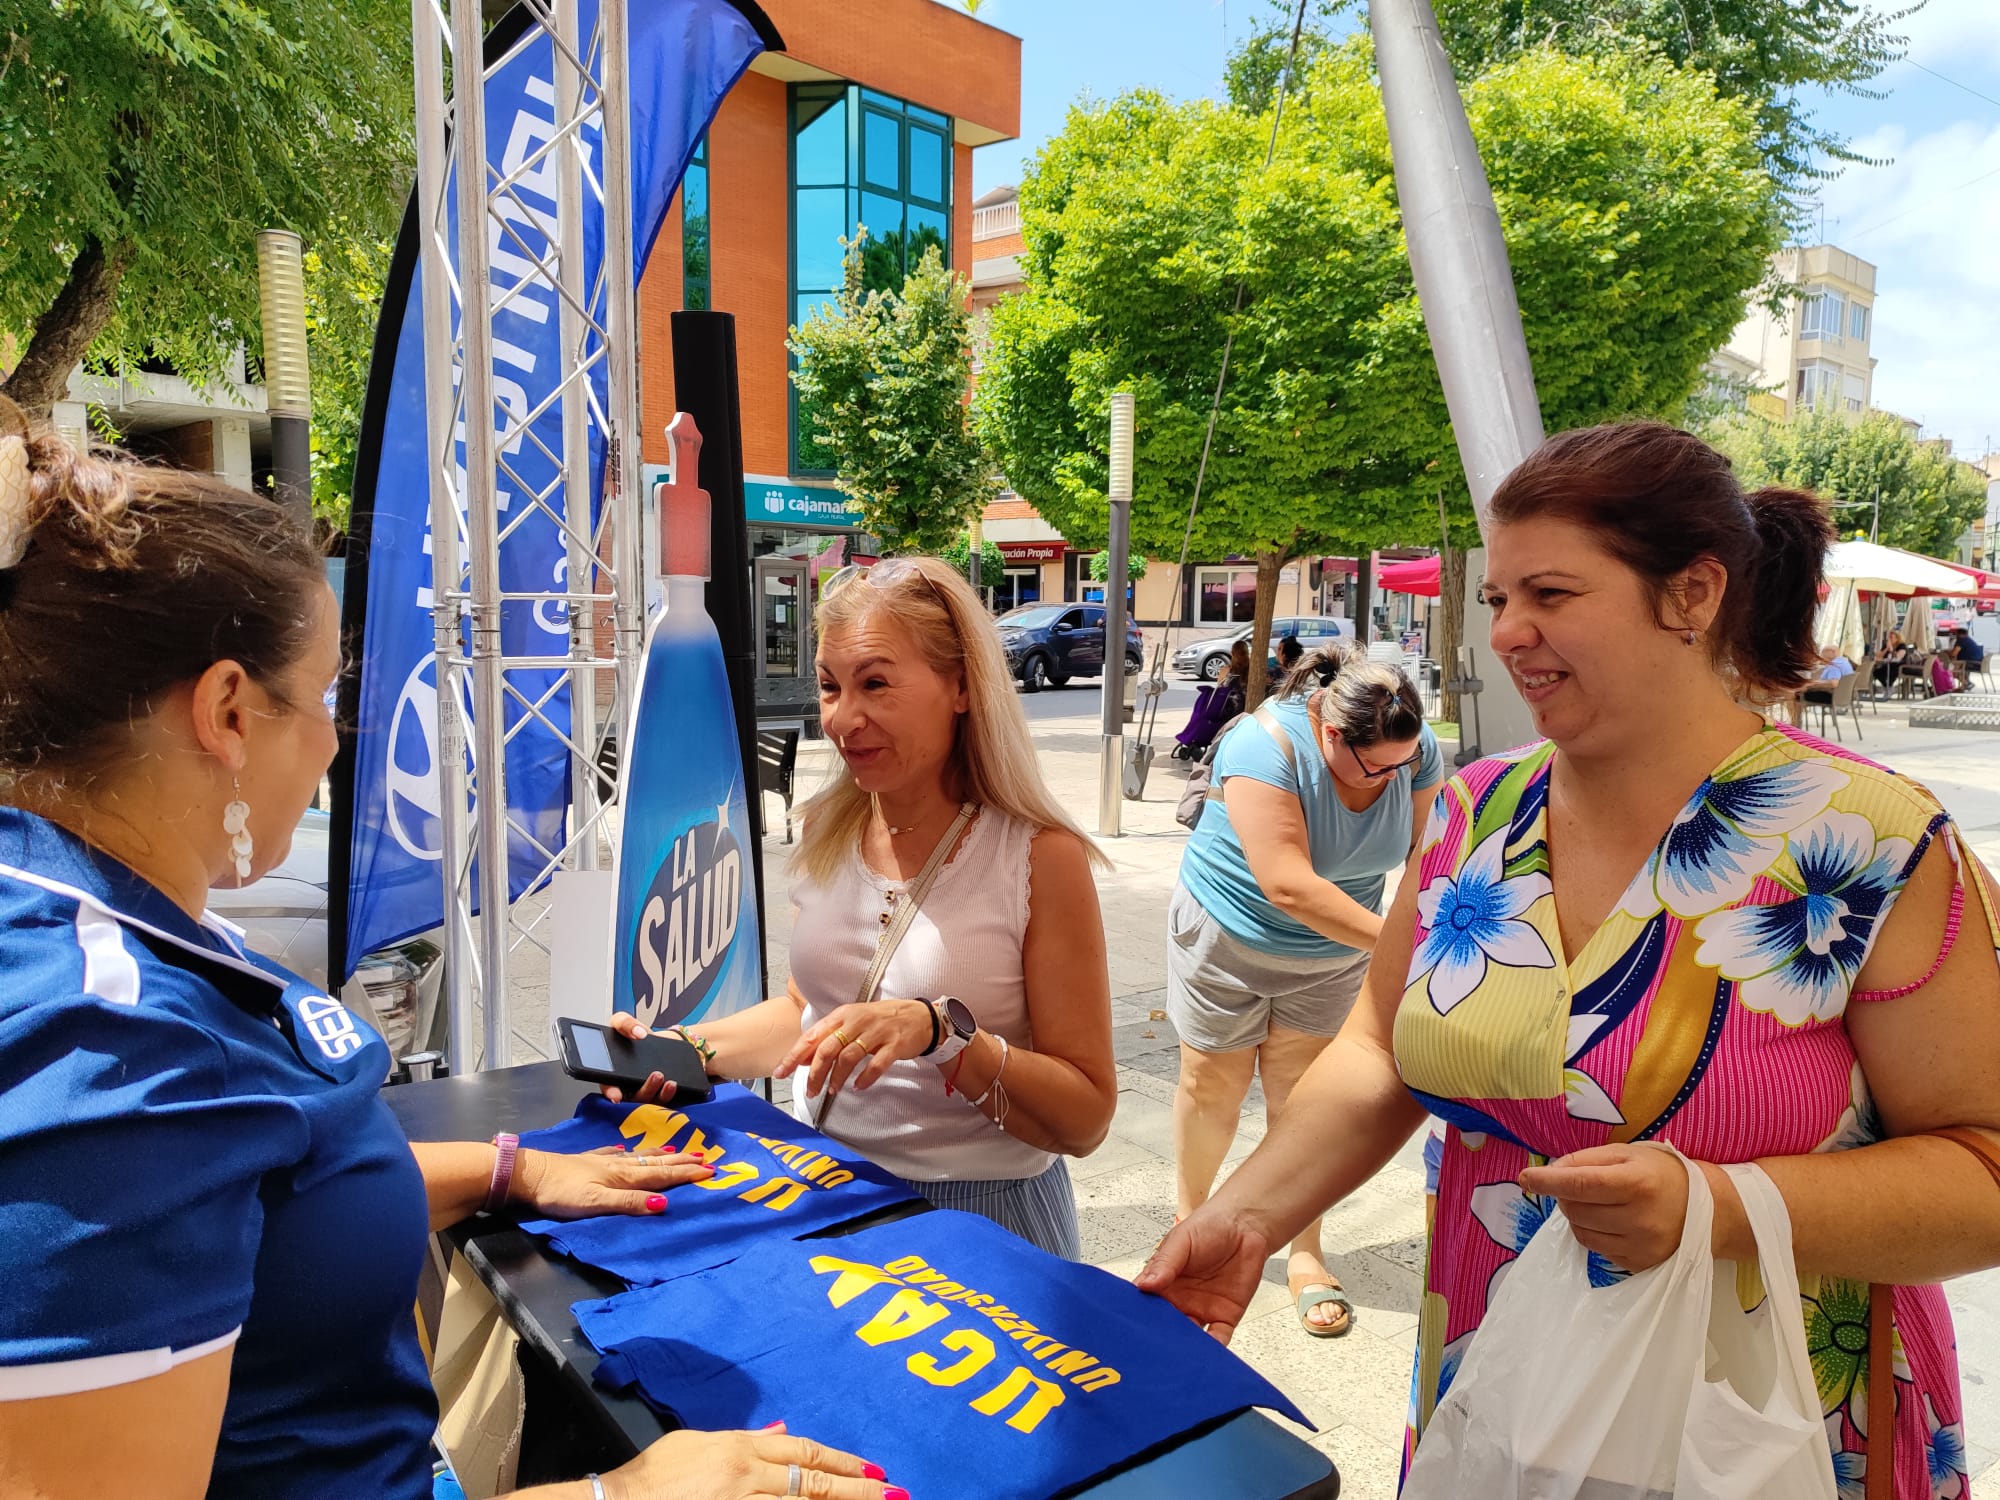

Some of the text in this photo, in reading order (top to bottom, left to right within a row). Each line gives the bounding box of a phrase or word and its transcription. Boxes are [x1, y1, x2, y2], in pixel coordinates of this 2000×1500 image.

[788, 495, 847, 517] cajamar
[1001, 547, 1026, 559] ración
[1026, 547, 1054, 560] Propia
[672, 828, 696, 893] LA
[635, 848, 740, 1029] SALUD
